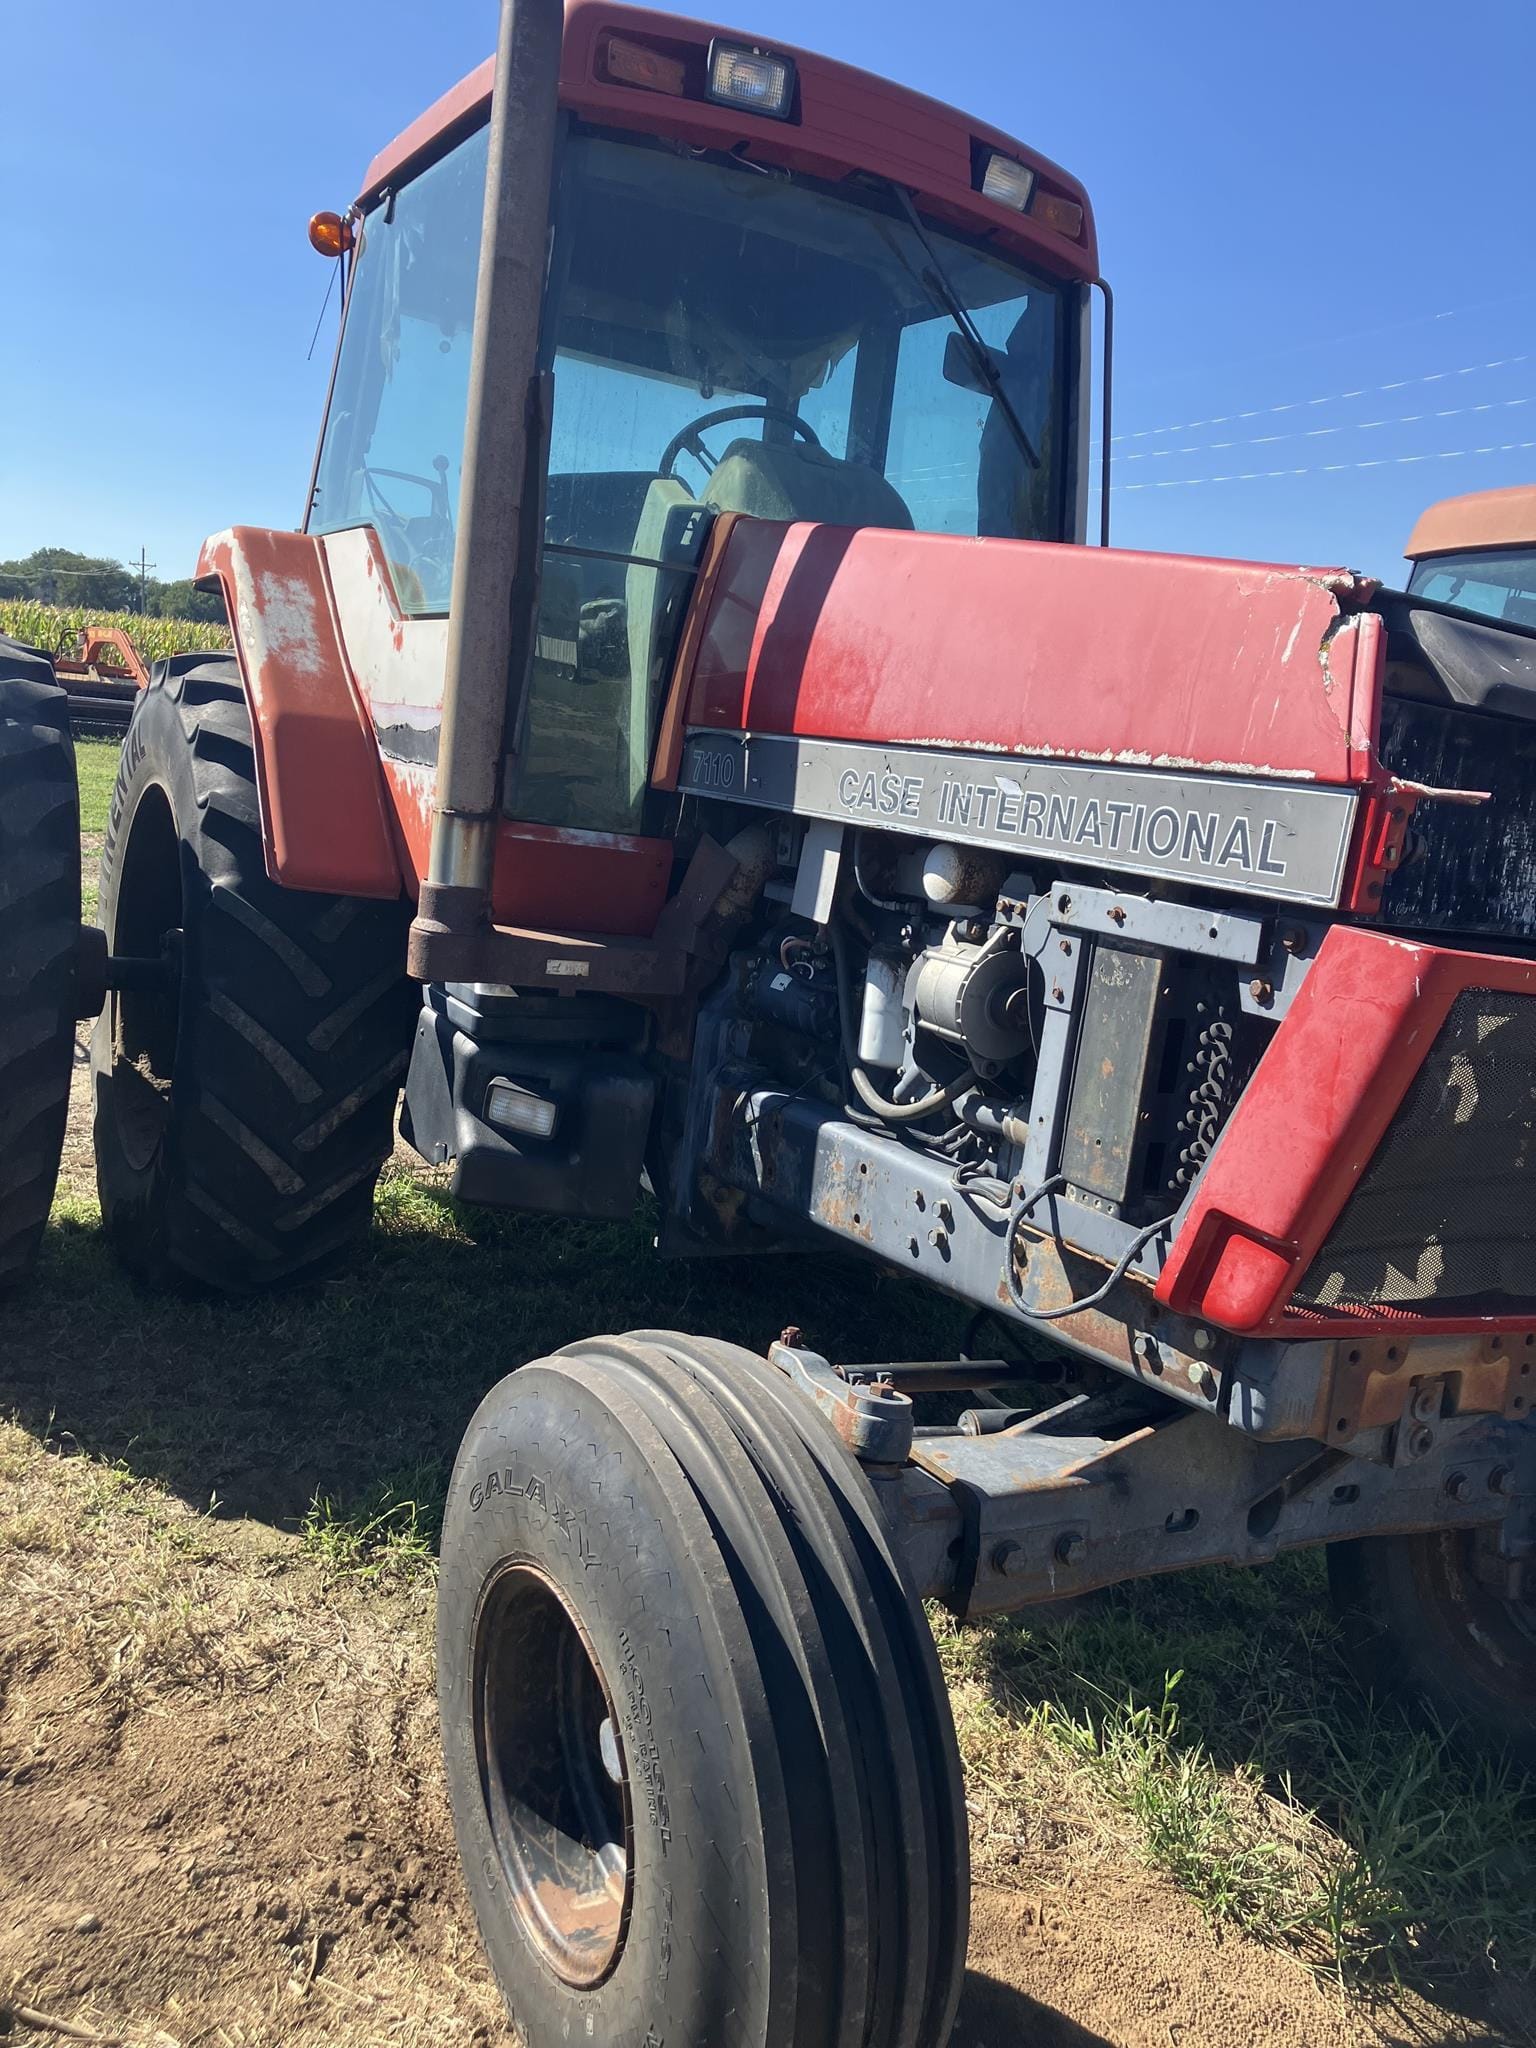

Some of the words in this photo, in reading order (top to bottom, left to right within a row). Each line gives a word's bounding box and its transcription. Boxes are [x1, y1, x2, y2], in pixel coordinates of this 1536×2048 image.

[692, 750, 735, 788] 7110
[838, 768, 924, 818] CASE
[937, 781, 1287, 877] INTERNATIONAL
[470, 1467, 602, 1570] GALAXY
[639, 1743, 658, 1826] RATING
